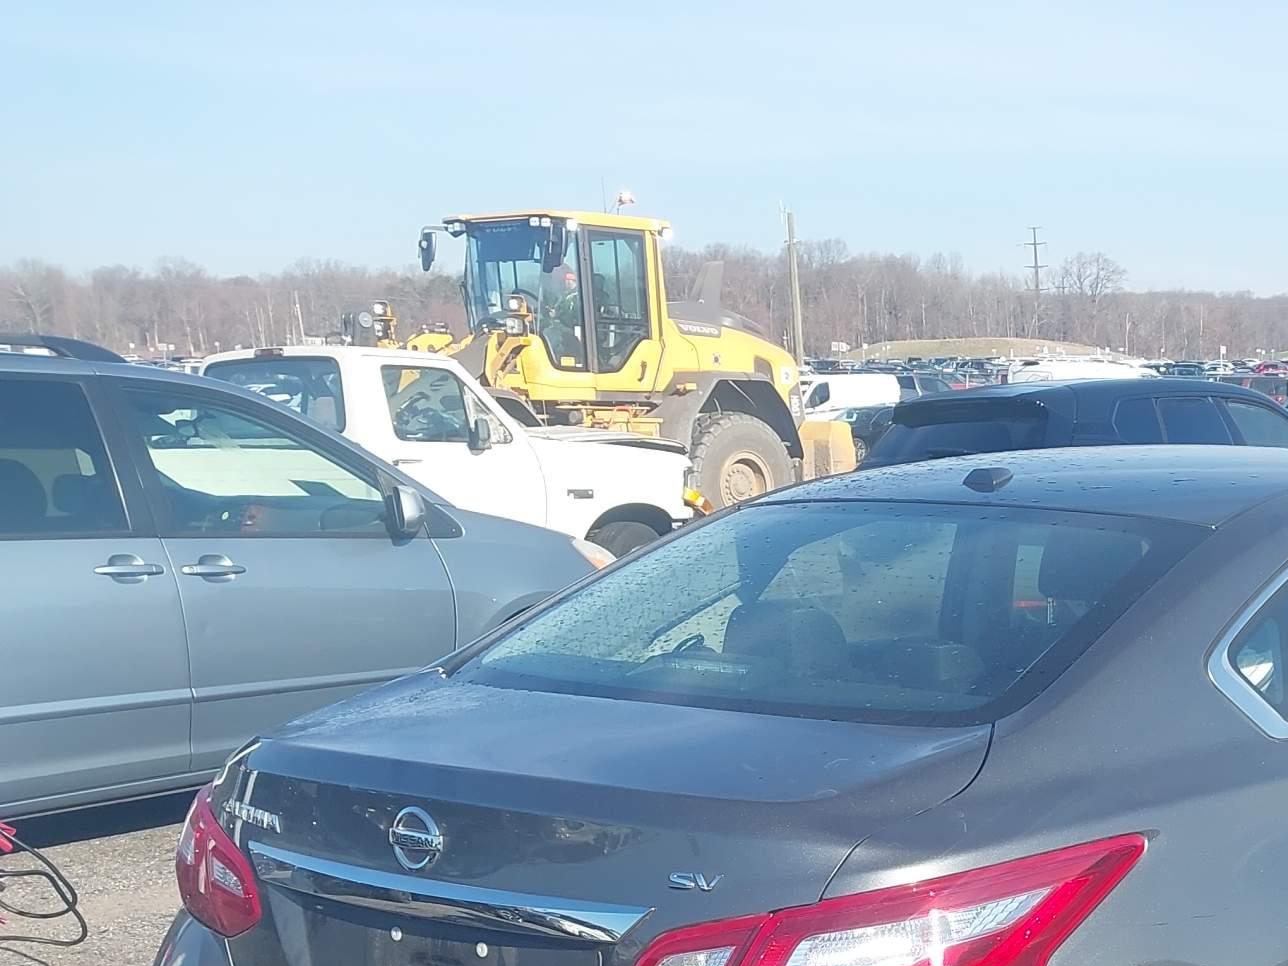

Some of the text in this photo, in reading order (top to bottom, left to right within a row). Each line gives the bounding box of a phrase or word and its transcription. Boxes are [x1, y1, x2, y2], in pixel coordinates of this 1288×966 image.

[678, 323, 719, 335] VOLVO
[390, 829, 438, 850] NISSAN
[668, 873, 725, 890] SV
